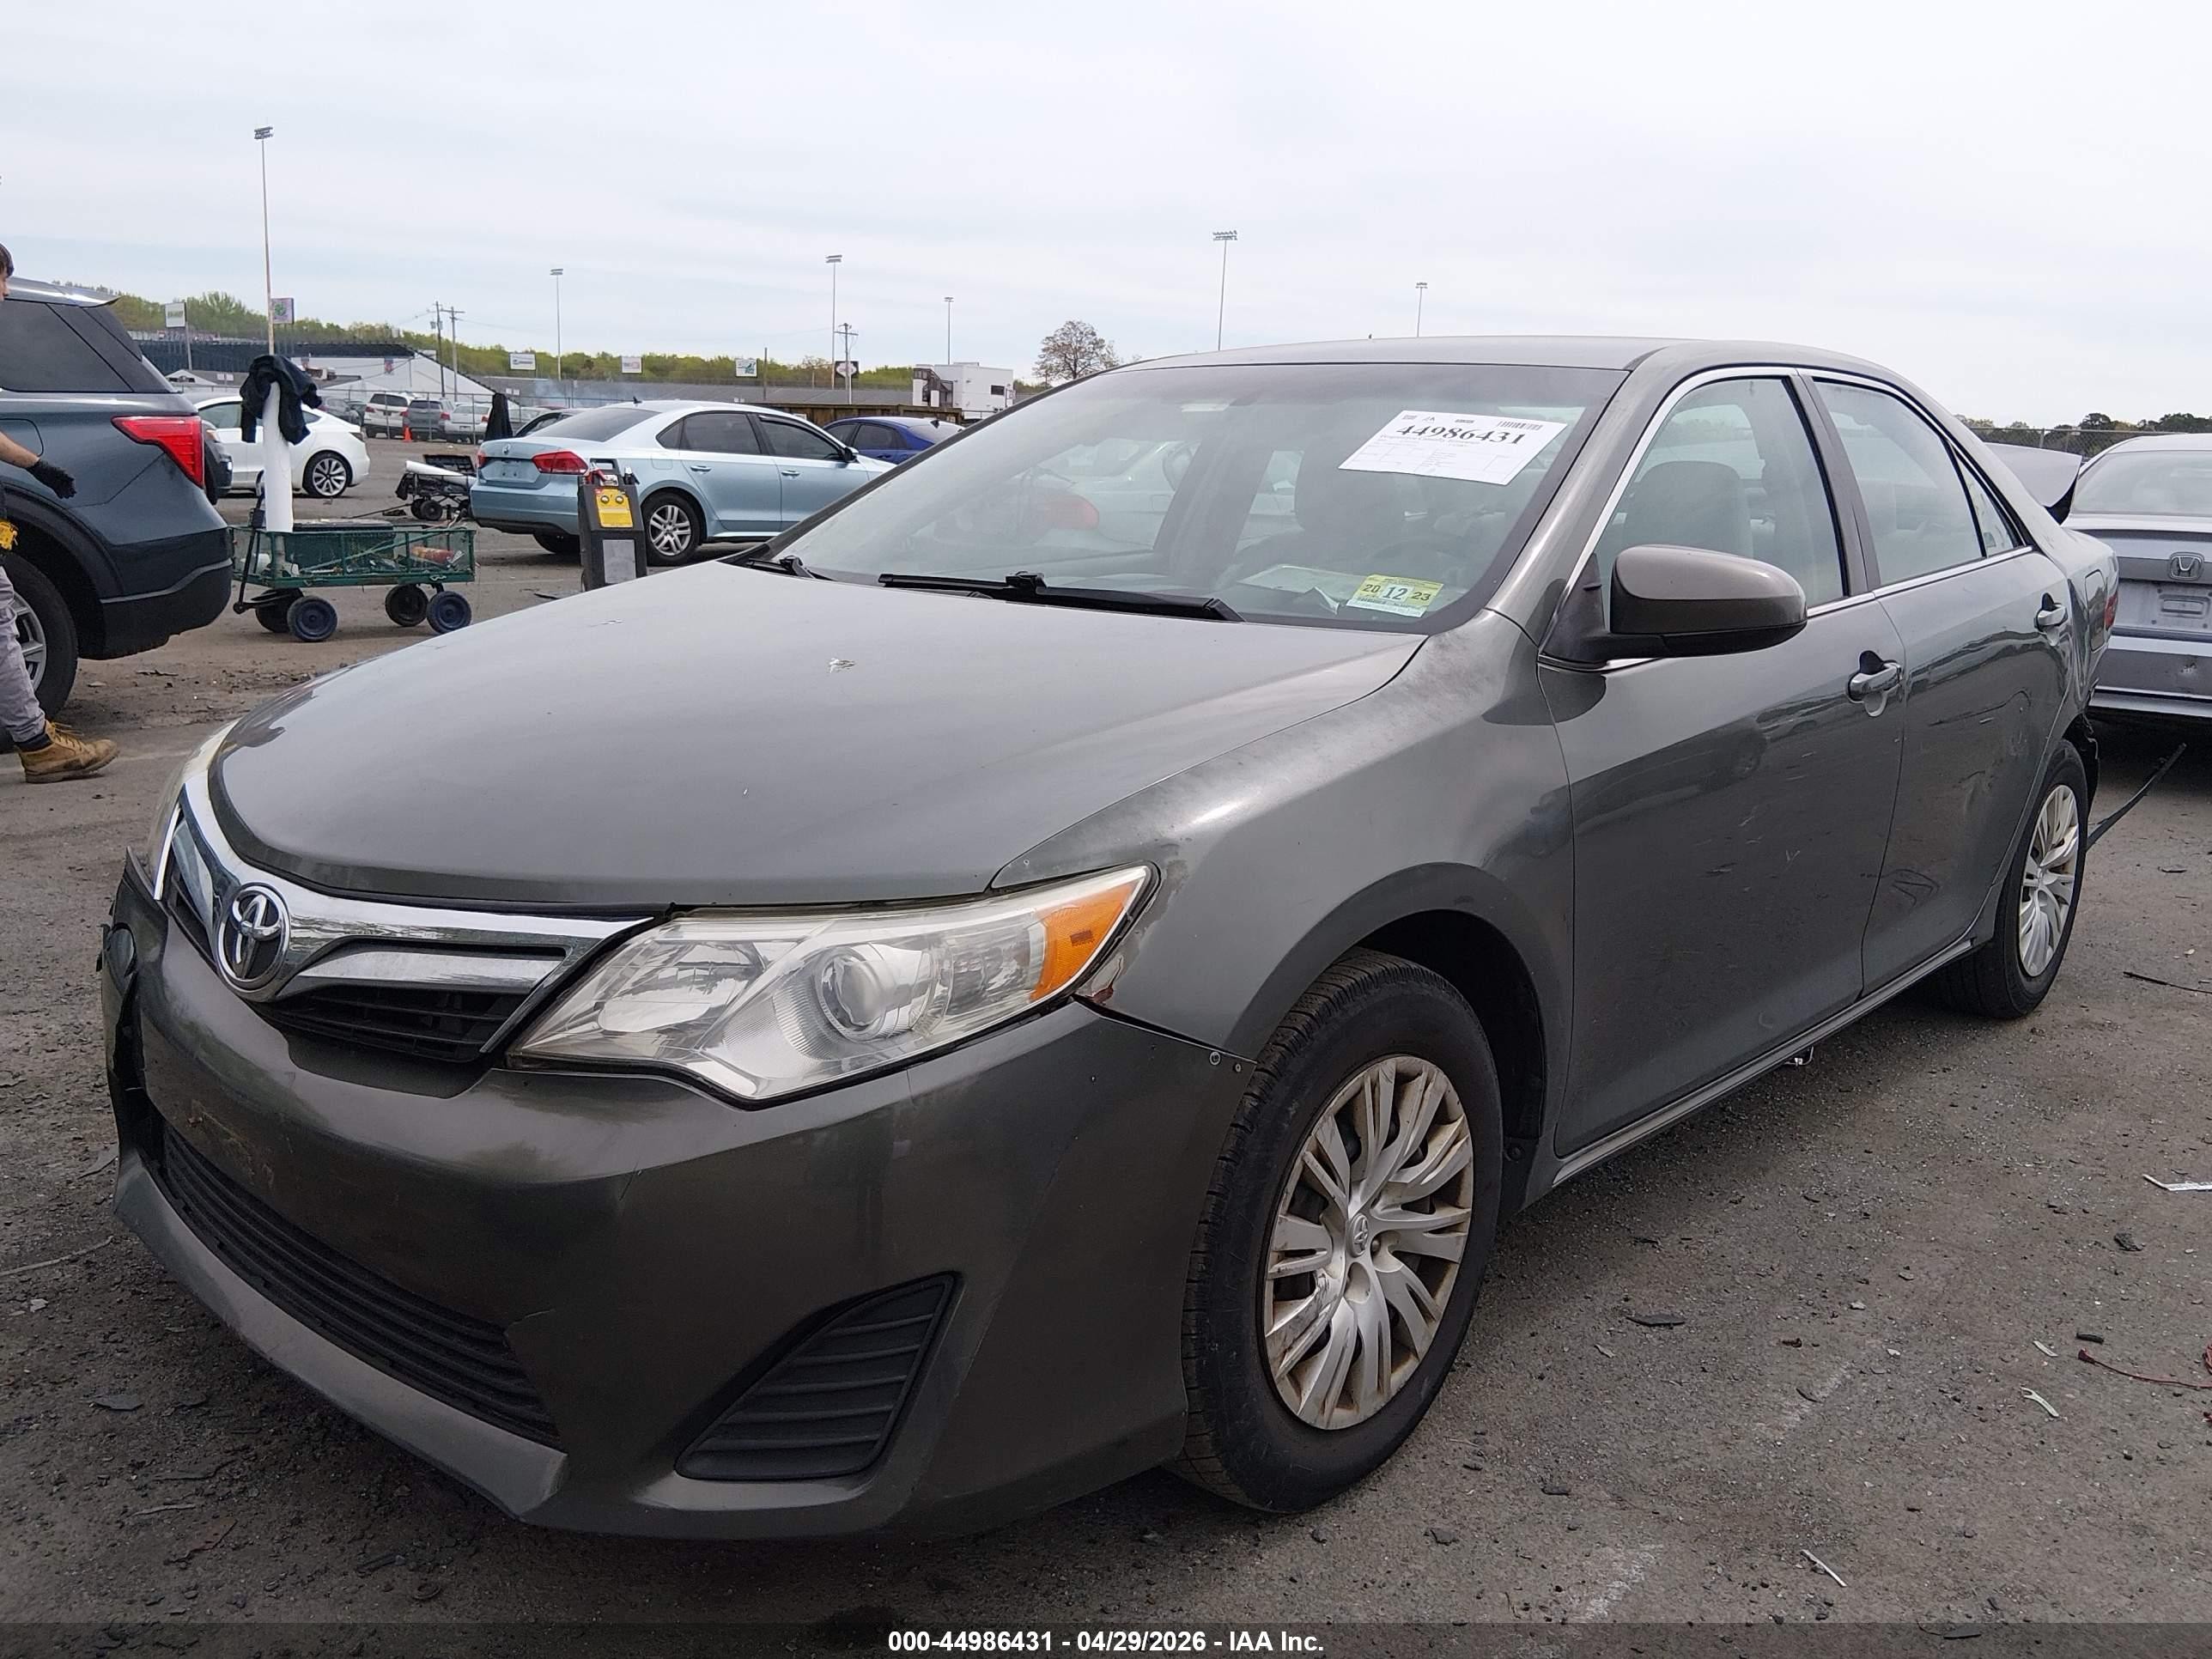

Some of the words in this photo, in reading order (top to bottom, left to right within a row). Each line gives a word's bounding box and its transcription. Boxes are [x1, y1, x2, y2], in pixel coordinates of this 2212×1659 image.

[1396, 424, 1526, 445] 44986431
[1363, 584, 1381, 593] 20
[1382, 586, 1408, 600] 12
[1412, 592, 1431, 601] 23
